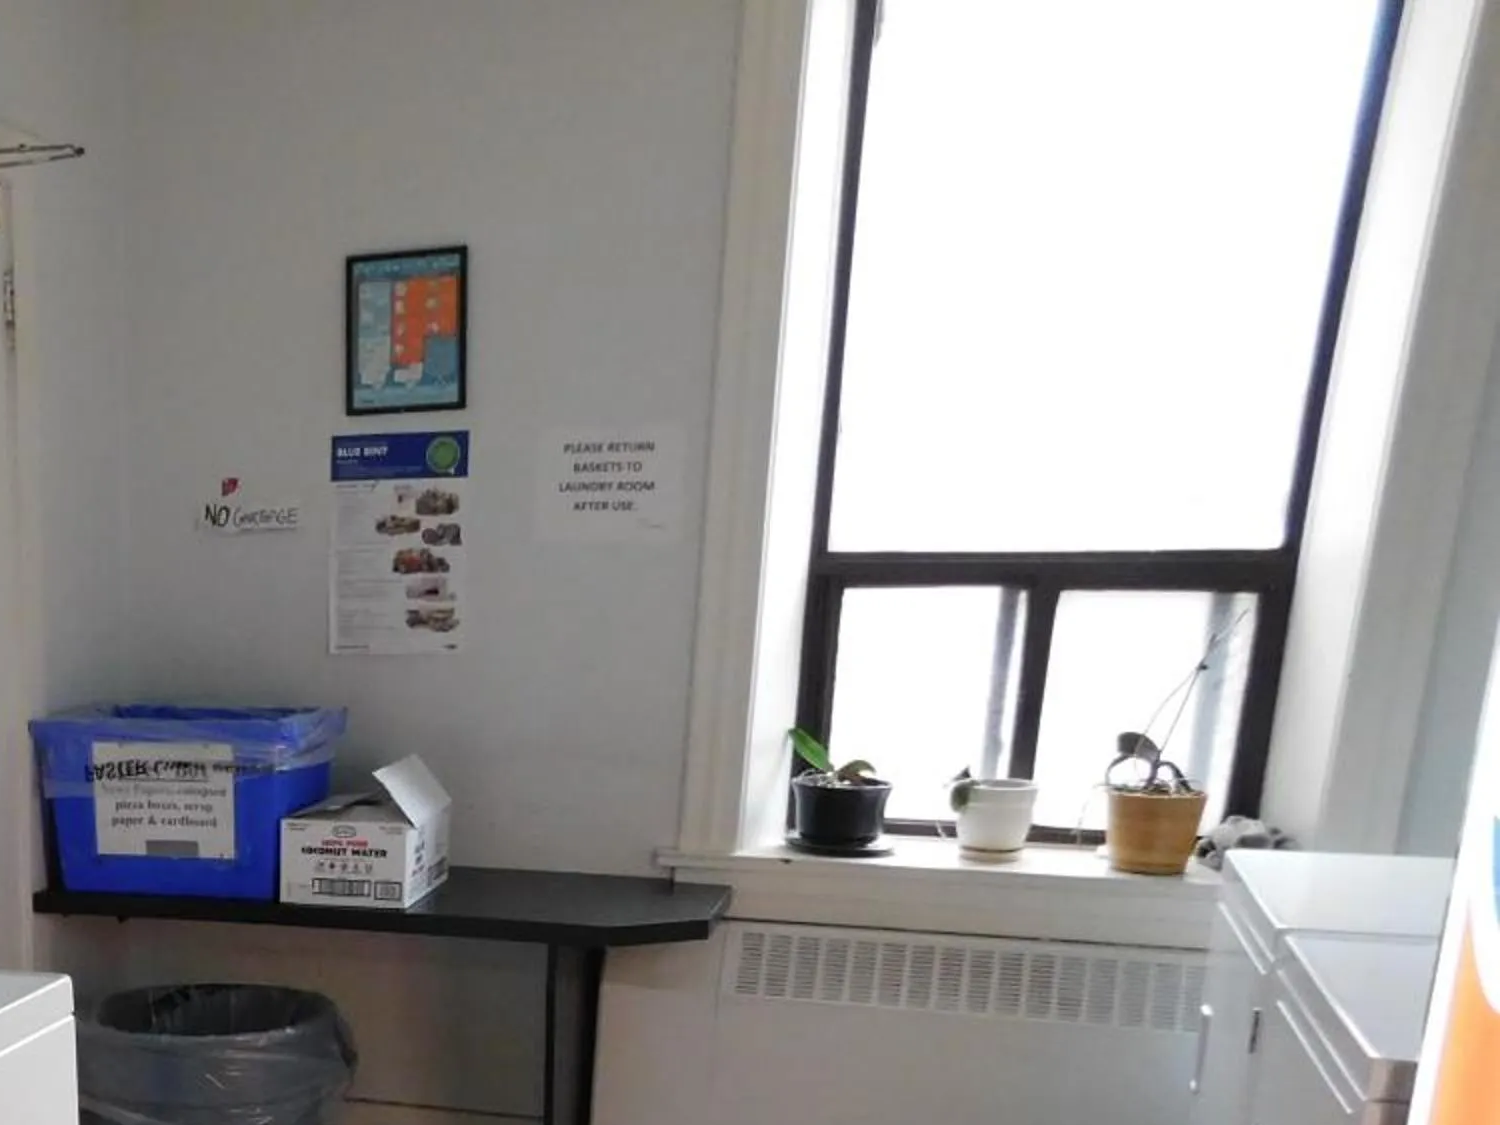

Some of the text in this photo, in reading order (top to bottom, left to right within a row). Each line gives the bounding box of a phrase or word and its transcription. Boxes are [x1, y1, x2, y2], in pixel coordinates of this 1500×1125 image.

[563, 441, 655, 454] PLEASE RETURN
[573, 461, 642, 474] BASKETS TO
[559, 481, 655, 493] LAUNDRY ROOM
[573, 500, 609, 511] AFTER
[204, 503, 230, 527] NO
[351, 848, 388, 858] WATER
